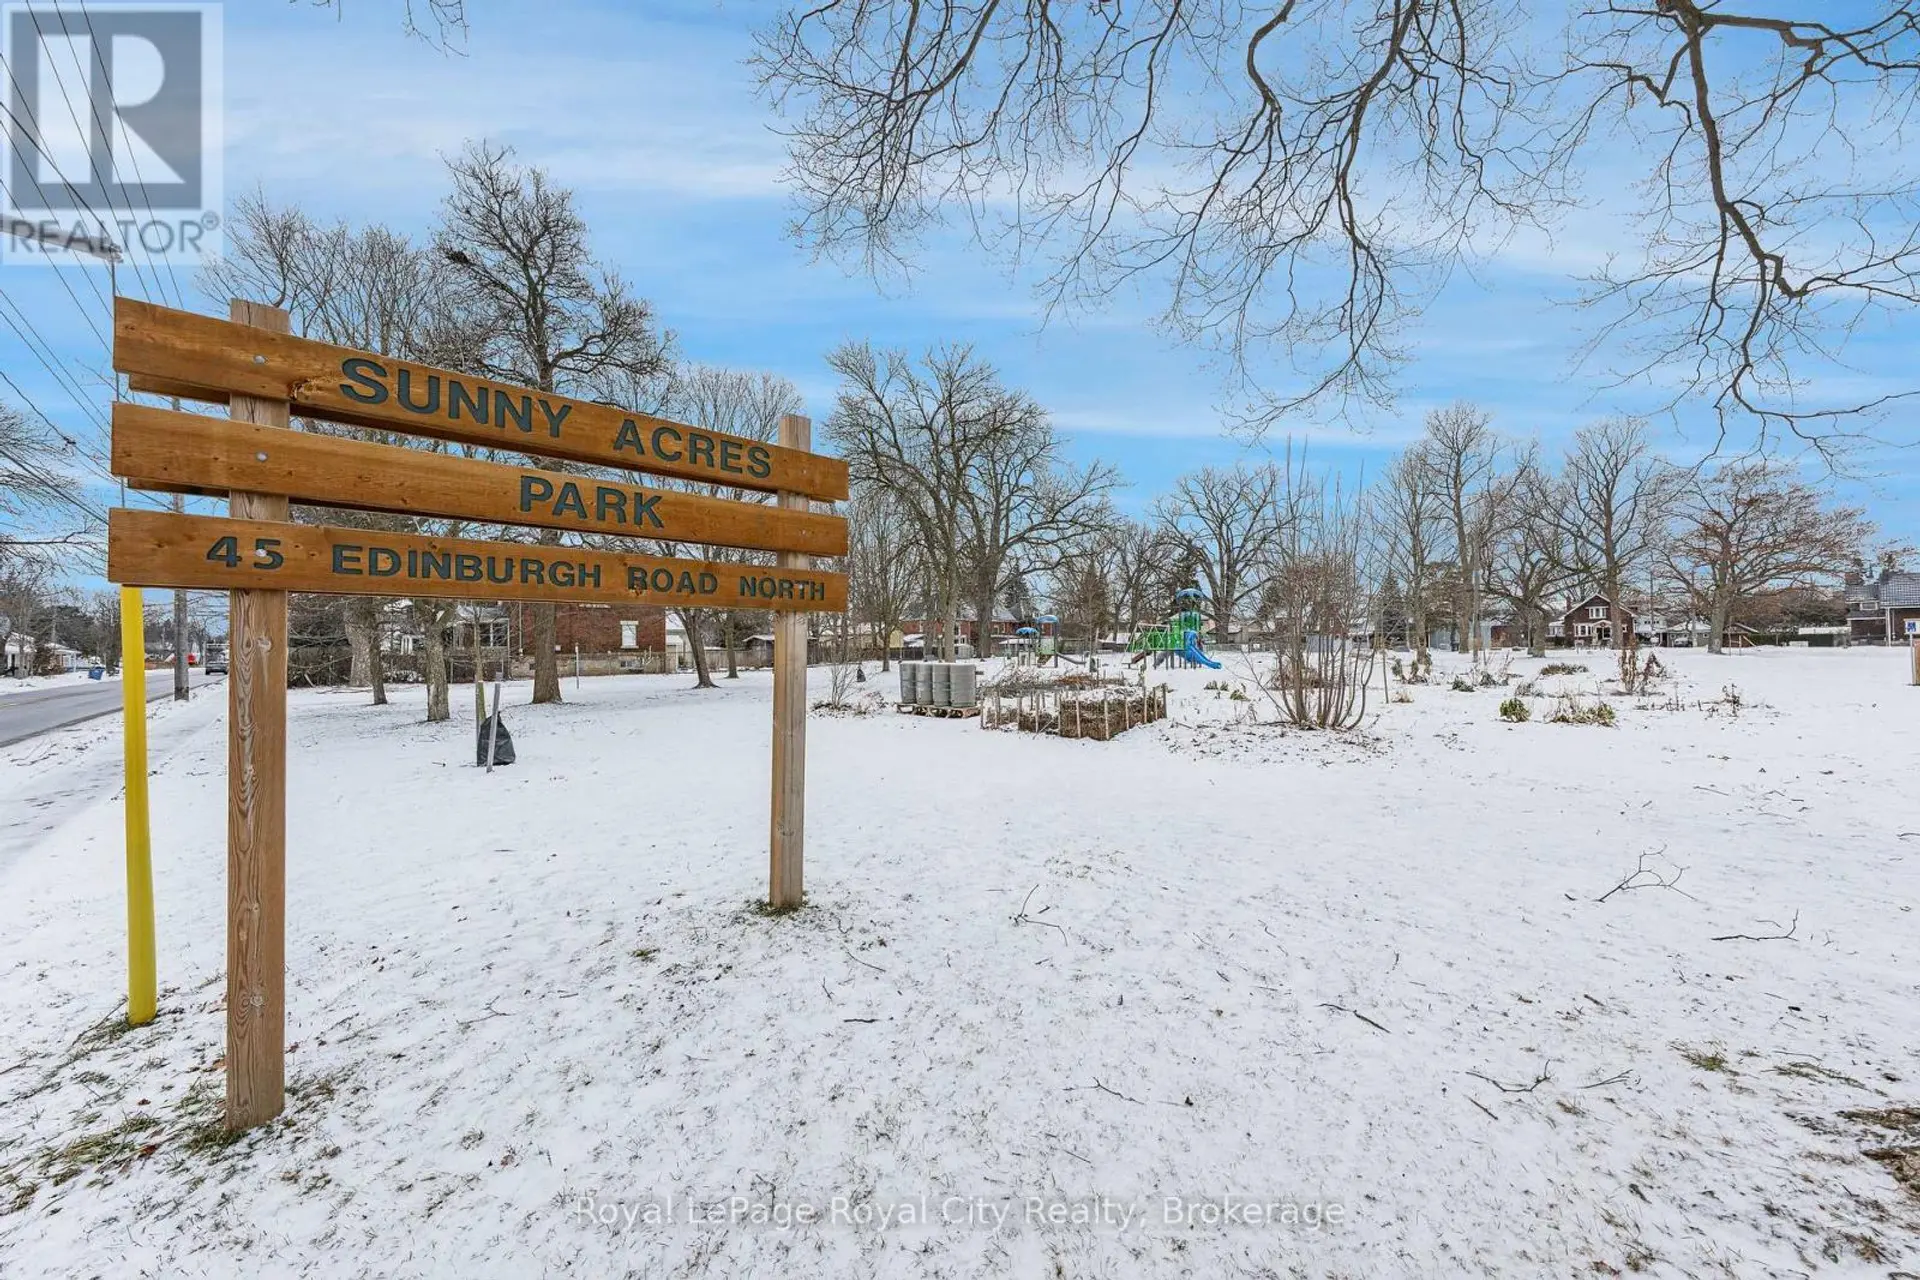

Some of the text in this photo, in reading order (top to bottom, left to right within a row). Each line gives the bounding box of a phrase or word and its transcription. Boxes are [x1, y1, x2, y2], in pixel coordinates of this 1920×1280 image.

[340, 358, 771, 478] SUNNY ACRES
[520, 475, 664, 529] PARK
[206, 536, 825, 601] 45 EDINBURGH ROAD NORTH
